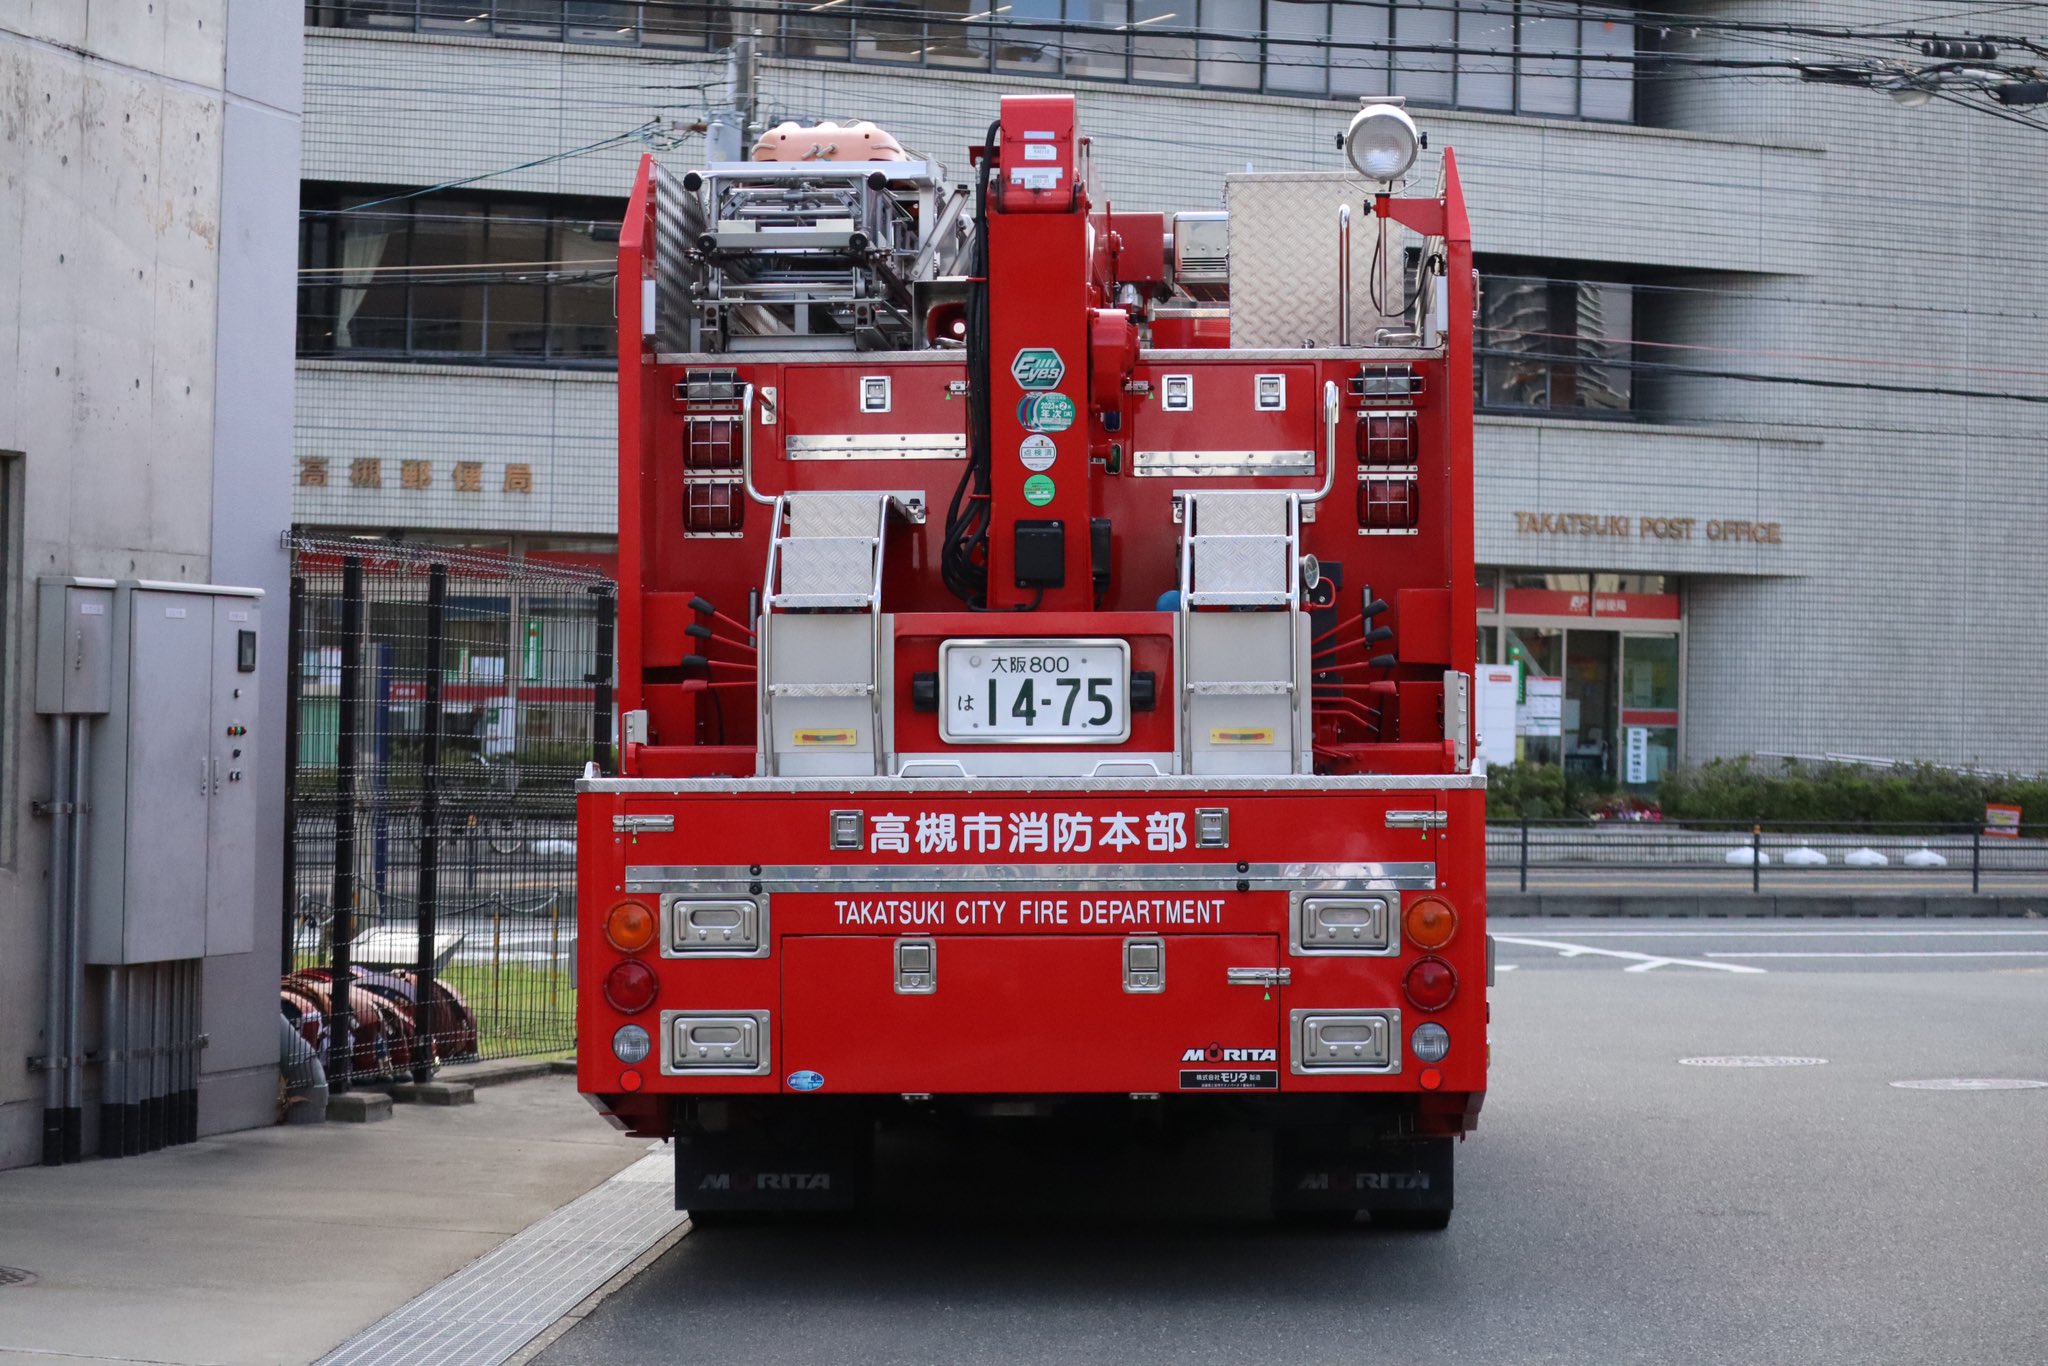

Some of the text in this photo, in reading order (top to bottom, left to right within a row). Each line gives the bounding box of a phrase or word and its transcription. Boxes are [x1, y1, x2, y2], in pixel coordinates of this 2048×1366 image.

[1014, 356, 1060, 382] Eyes
[299, 456, 534, 495] 高槻郵便局
[1515, 511, 1783, 545] TAKATSUKI POST OFFICE
[957, 678, 1113, 726] は 14-75
[870, 811, 1188, 854] 高槻市消防本部
[834, 900, 1226, 925] TAKATSUKI CITY FIRE DEPARTMENT
[1181, 1043, 1277, 1062] MORITA
